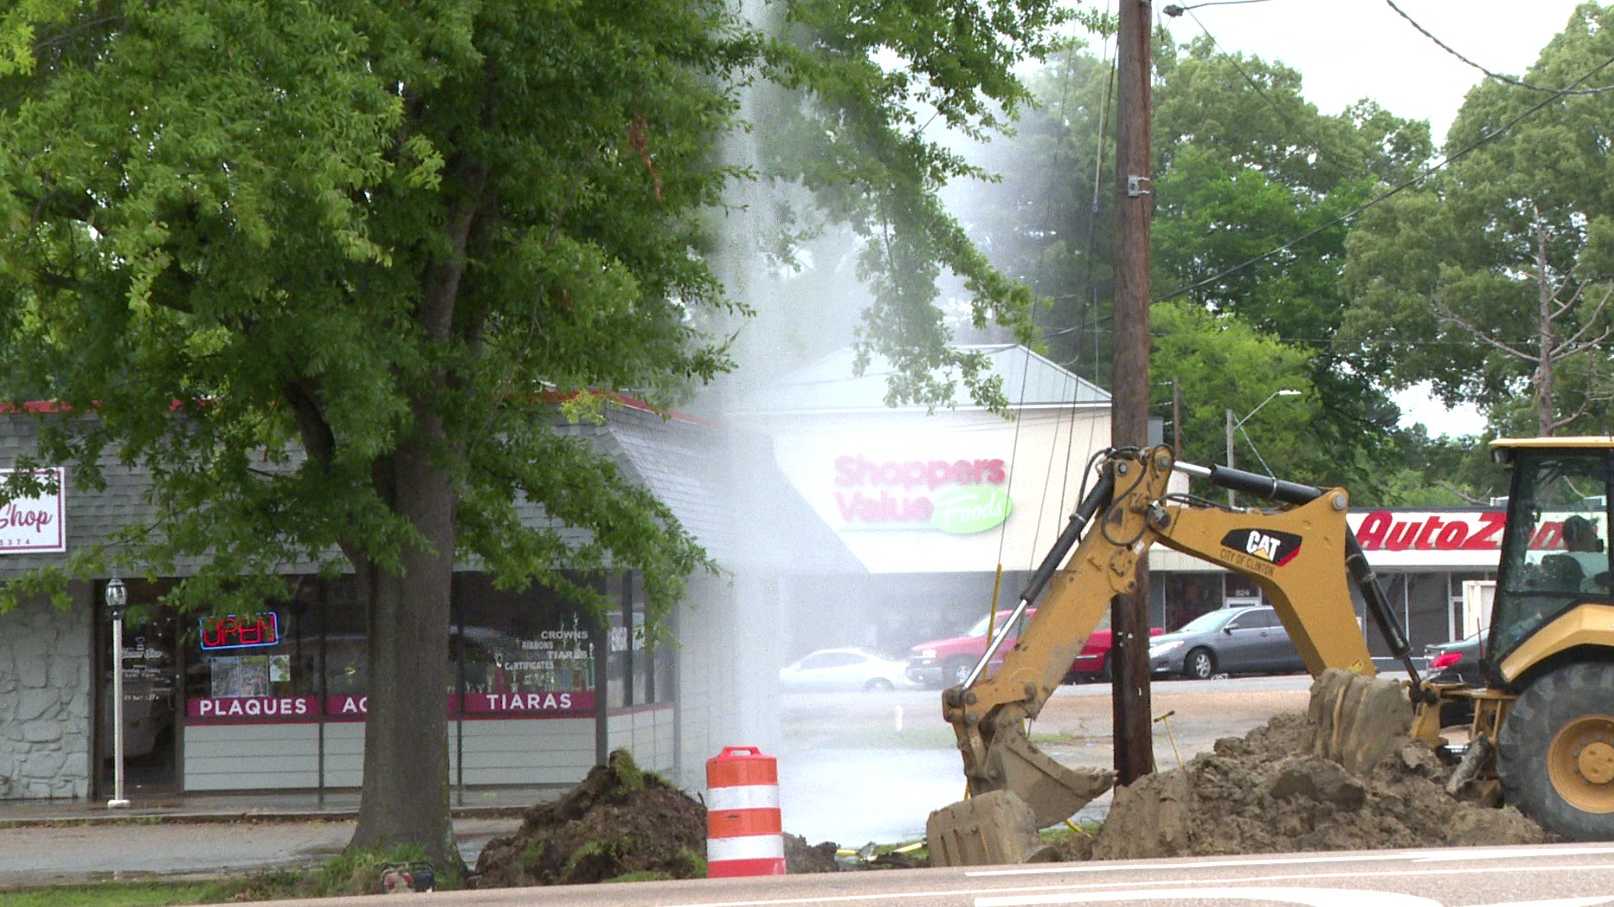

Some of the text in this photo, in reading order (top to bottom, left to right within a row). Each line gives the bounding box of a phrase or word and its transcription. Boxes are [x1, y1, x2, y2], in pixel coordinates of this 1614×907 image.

[834, 454, 1006, 491] Shoppers
[833, 490, 935, 522] Value
[1246, 530, 1281, 561] CAT
[541, 630, 588, 640] CROWNS
[521, 640, 554, 649] RIBBONS
[200, 698, 307, 716] PLAQUES
[486, 693, 572, 710] TIARAS
